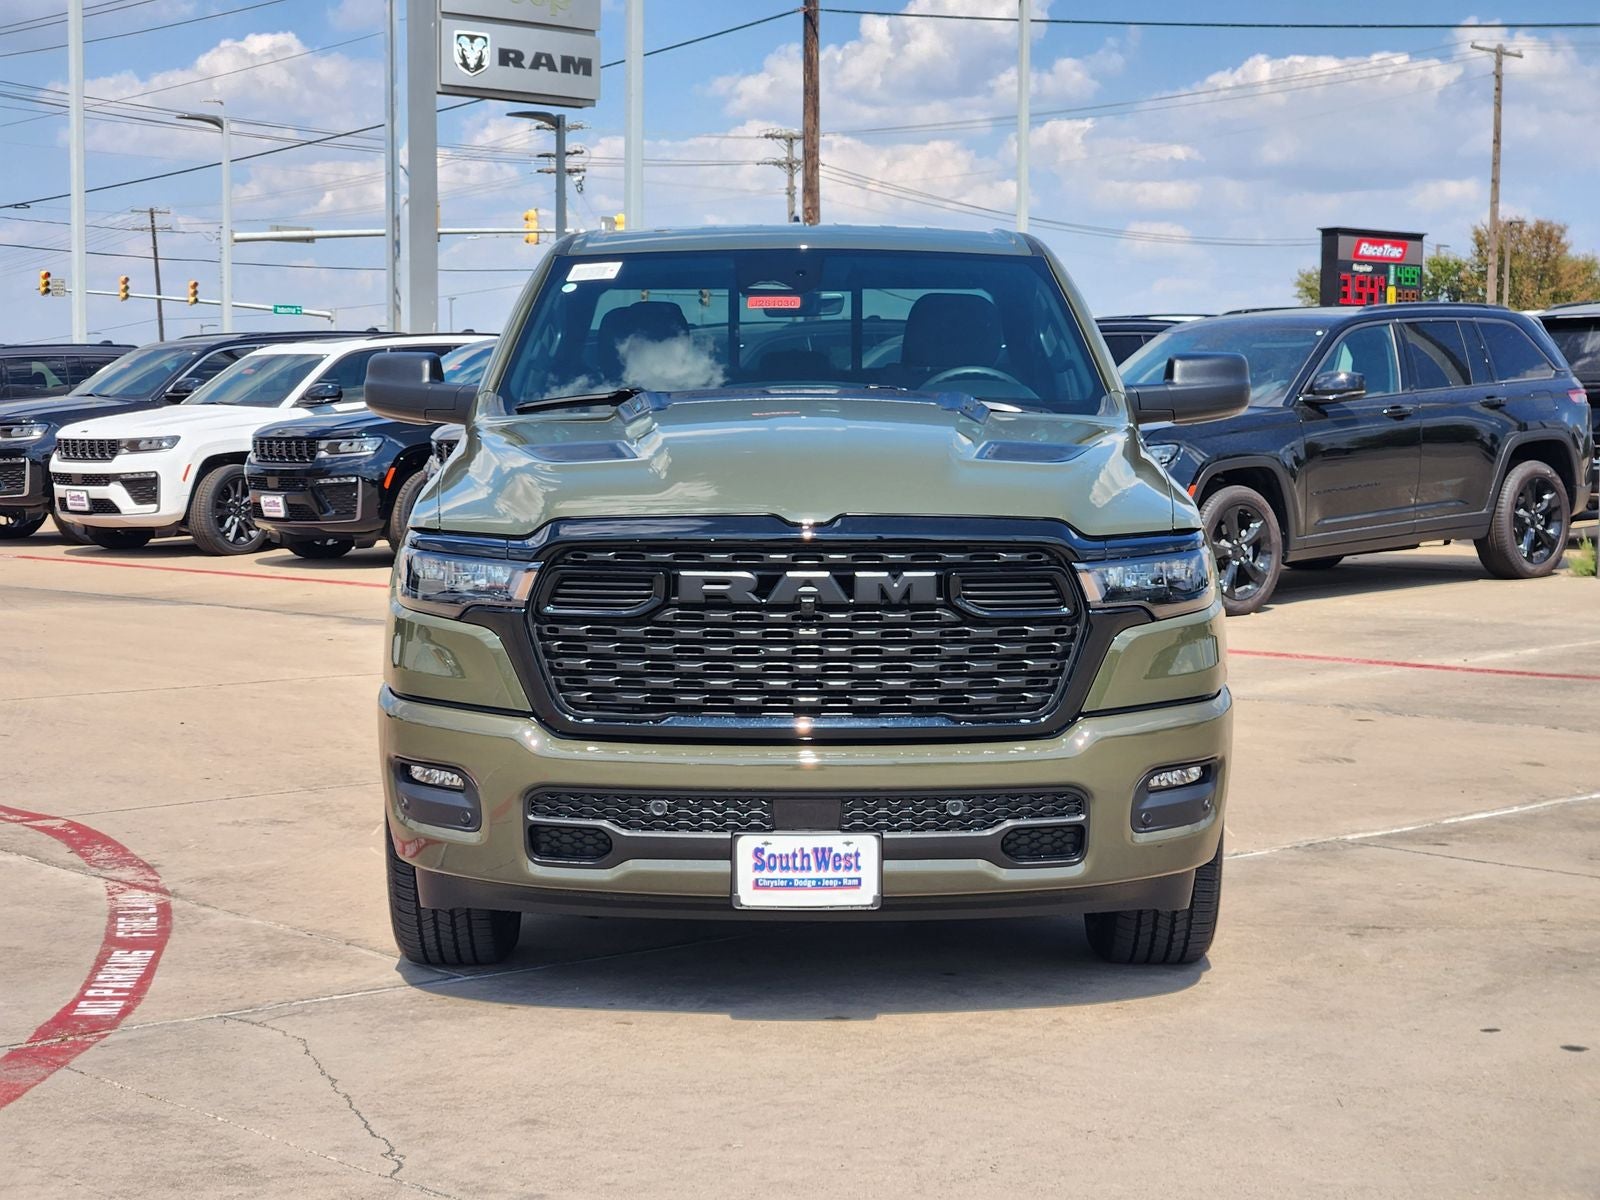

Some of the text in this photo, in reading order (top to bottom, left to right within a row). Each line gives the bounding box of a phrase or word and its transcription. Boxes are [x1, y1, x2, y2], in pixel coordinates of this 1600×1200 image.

[498, 48, 592, 77] RAM
[1358, 242, 1404, 258] RaceTrac
[678, 571, 938, 605] RAM
[752, 846, 862, 874] SouthWest
[757, 878, 859, 888] Chrysler Dodge Jeep Ram
[115, 917, 158, 937] FIRE
[84, 950, 156, 996] PARKING
[72, 1000, 125, 1015] NO
